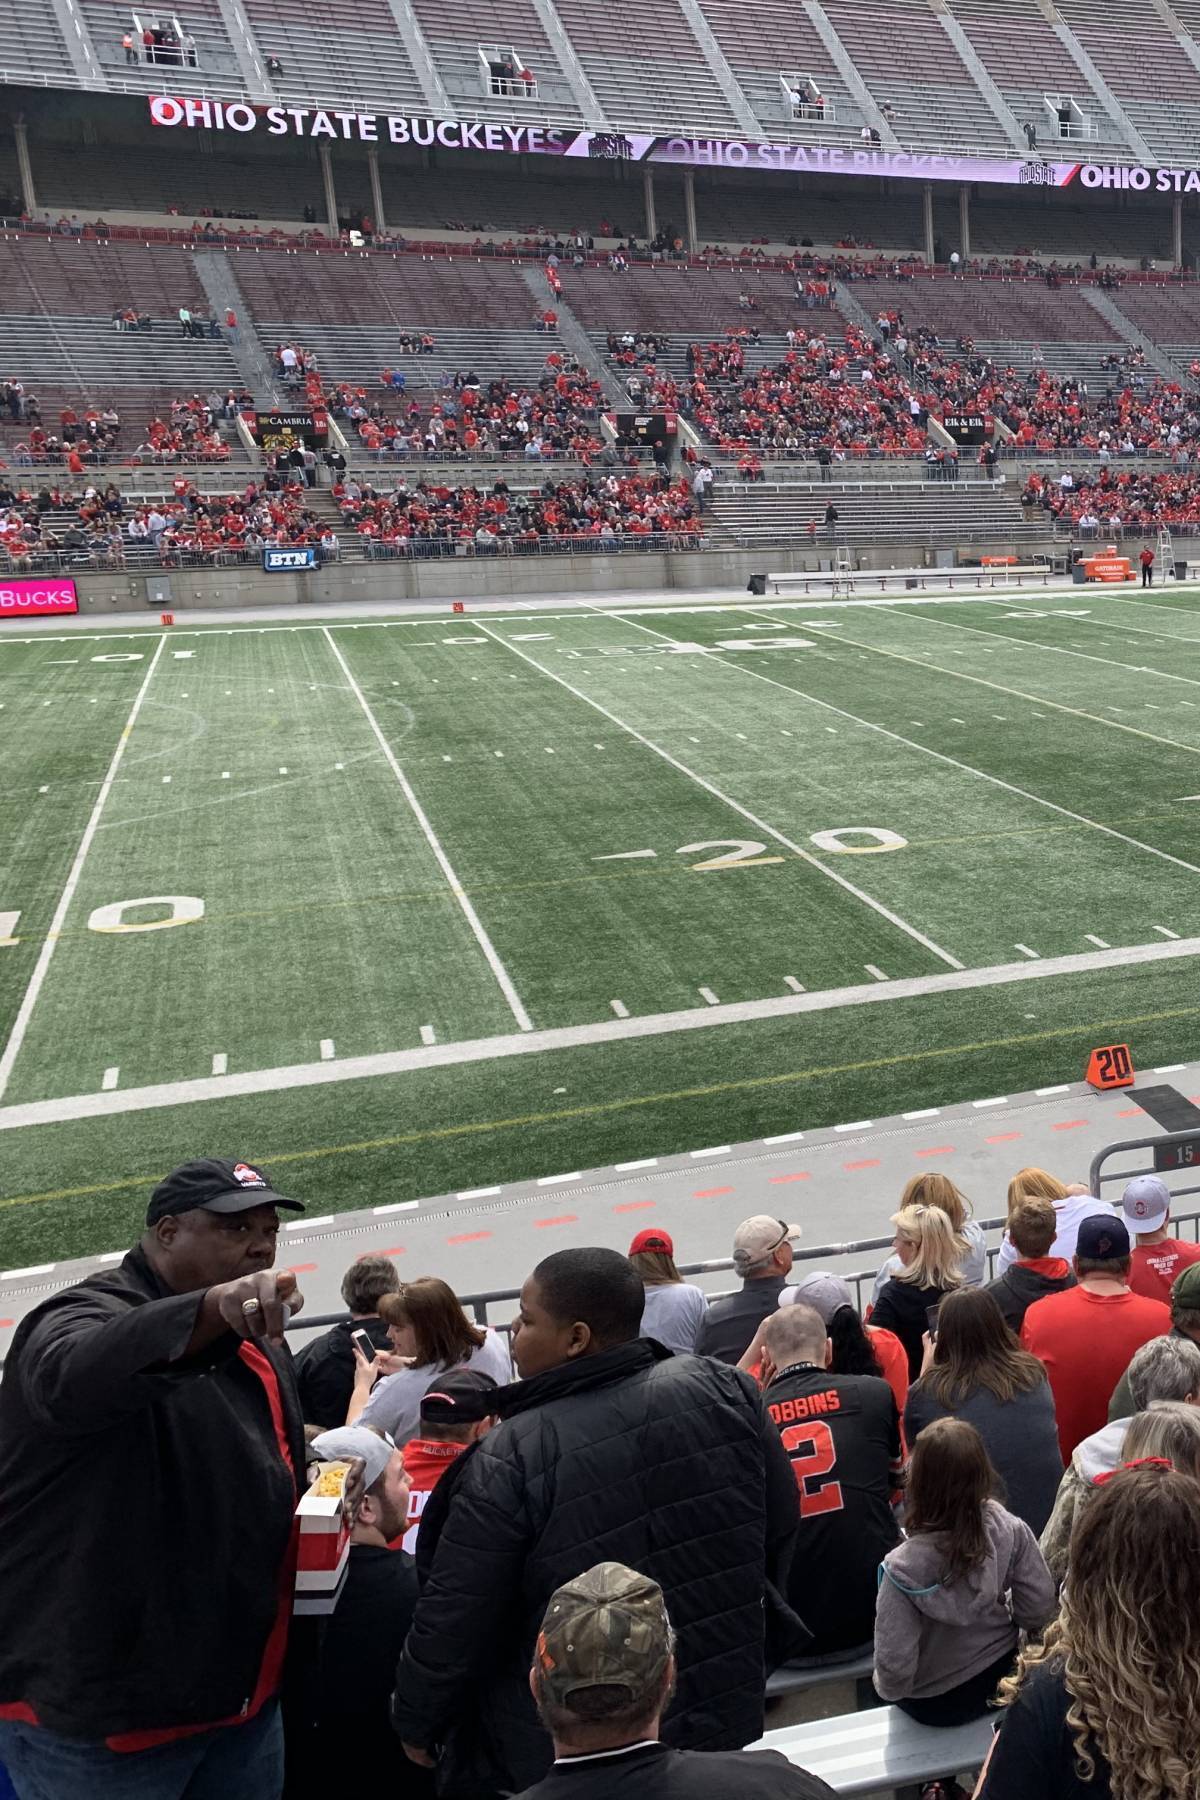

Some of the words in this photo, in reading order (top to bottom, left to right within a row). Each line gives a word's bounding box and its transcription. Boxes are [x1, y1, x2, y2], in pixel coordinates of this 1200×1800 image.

[151, 97, 257, 132] OHIO
[267, 107, 378, 142] STATE
[388, 116, 565, 152] BUCKEYES
[667, 138, 749, 167] OHIO
[758, 144, 844, 168] STATE
[1080, 165, 1150, 191] OHIO
[269, 416, 312, 426] CAMBRIA
[944, 418, 959, 427] Elk
[960, 418, 968, 427] &
[969, 418, 984, 427] Elk
[269, 552, 308, 566] BTN
[674, 826, 909, 873] 20
[1096, 1046, 1131, 1083] 20
[1176, 1145, 1194, 1164] 15
[780, 1420, 845, 1519] 2
